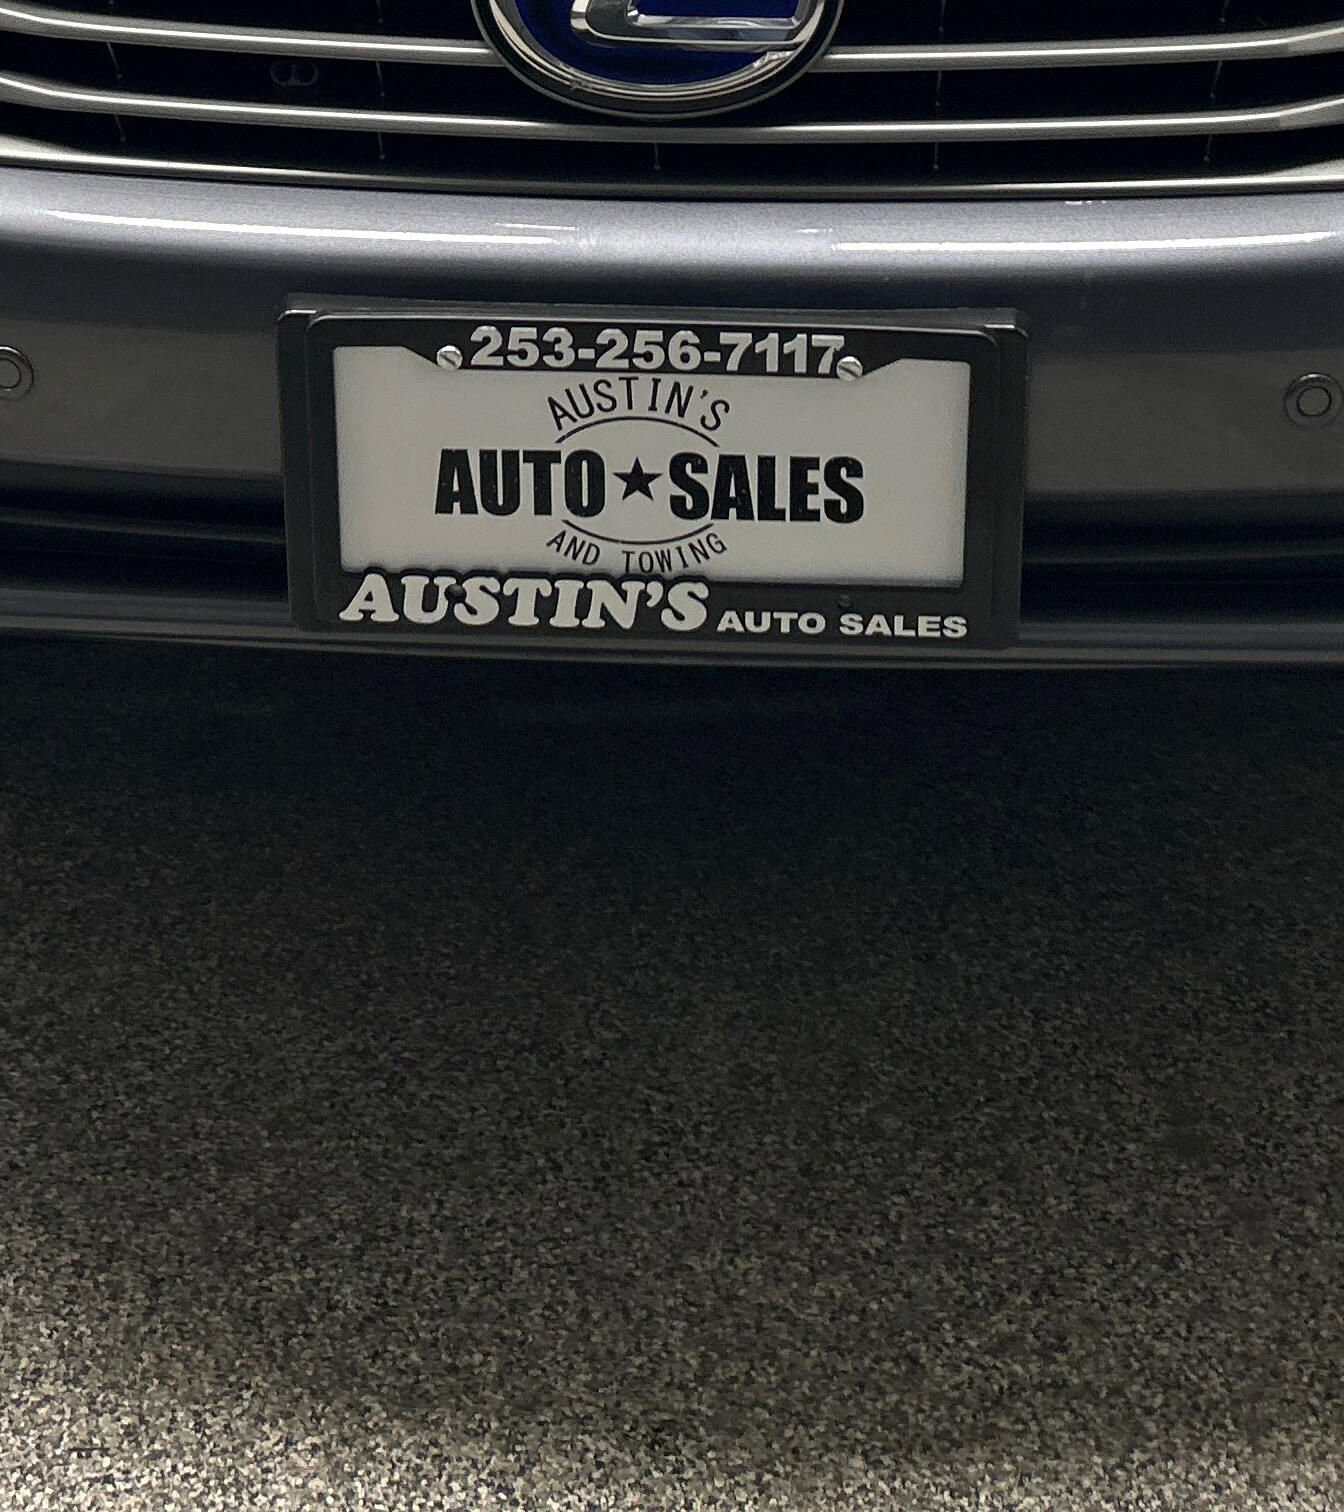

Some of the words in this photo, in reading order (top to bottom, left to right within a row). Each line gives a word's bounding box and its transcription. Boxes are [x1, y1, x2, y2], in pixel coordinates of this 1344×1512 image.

[469, 325, 845, 375] 253-256-7117
[546, 375, 731, 432] AUSTIN'S
[434, 447, 607, 519] AUTO
[668, 451, 865, 524] SALES
[546, 529, 601, 567] AND
[621, 531, 728, 574] TOWING
[339, 572, 710, 631] AUSTIN'S
[716, 611, 826, 635] AUTO
[839, 613, 969, 639] SALES
